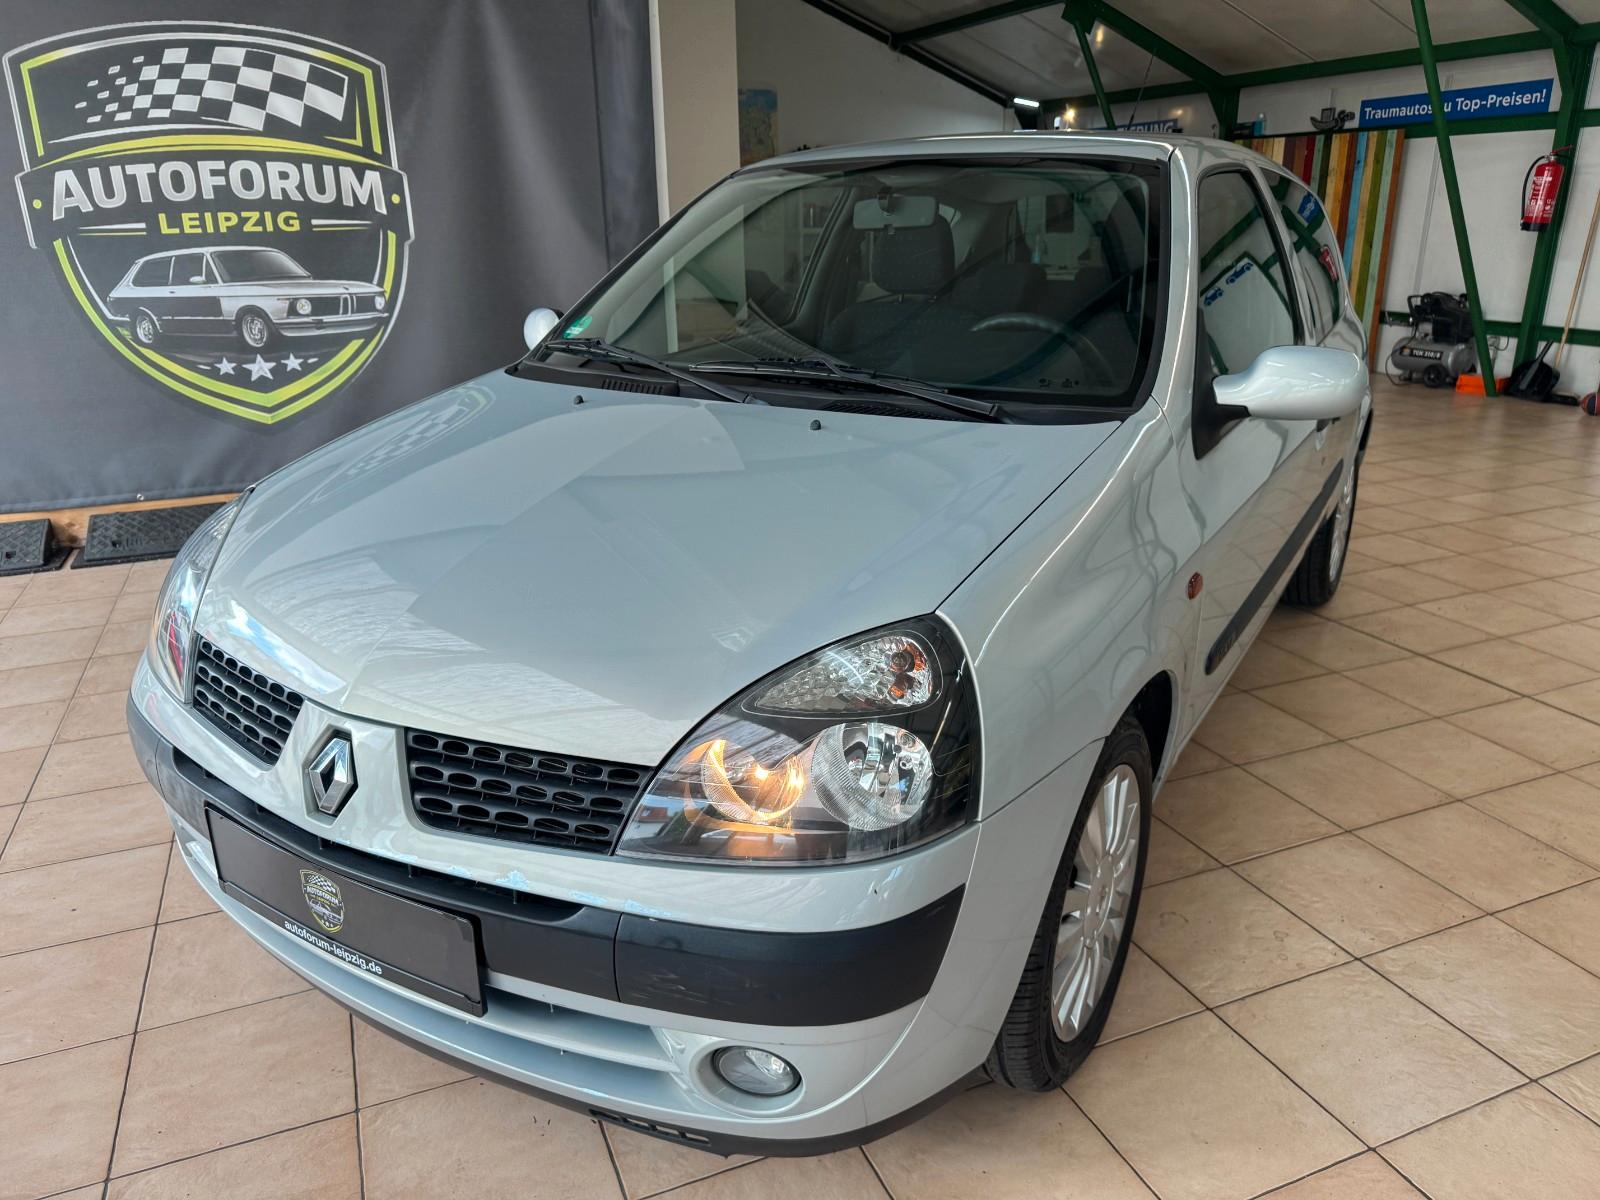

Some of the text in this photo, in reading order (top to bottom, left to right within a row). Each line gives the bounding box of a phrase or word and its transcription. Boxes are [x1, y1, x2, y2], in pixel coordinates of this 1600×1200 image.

[1364, 101, 1433, 120] Traumautos
[1455, 88, 1547, 113] Top-Preisen!
[53, 160, 387, 221] AUTOFORUM
[158, 211, 300, 235] LEIPZIG
[284, 921, 383, 975] autoforum-leipzig.de
